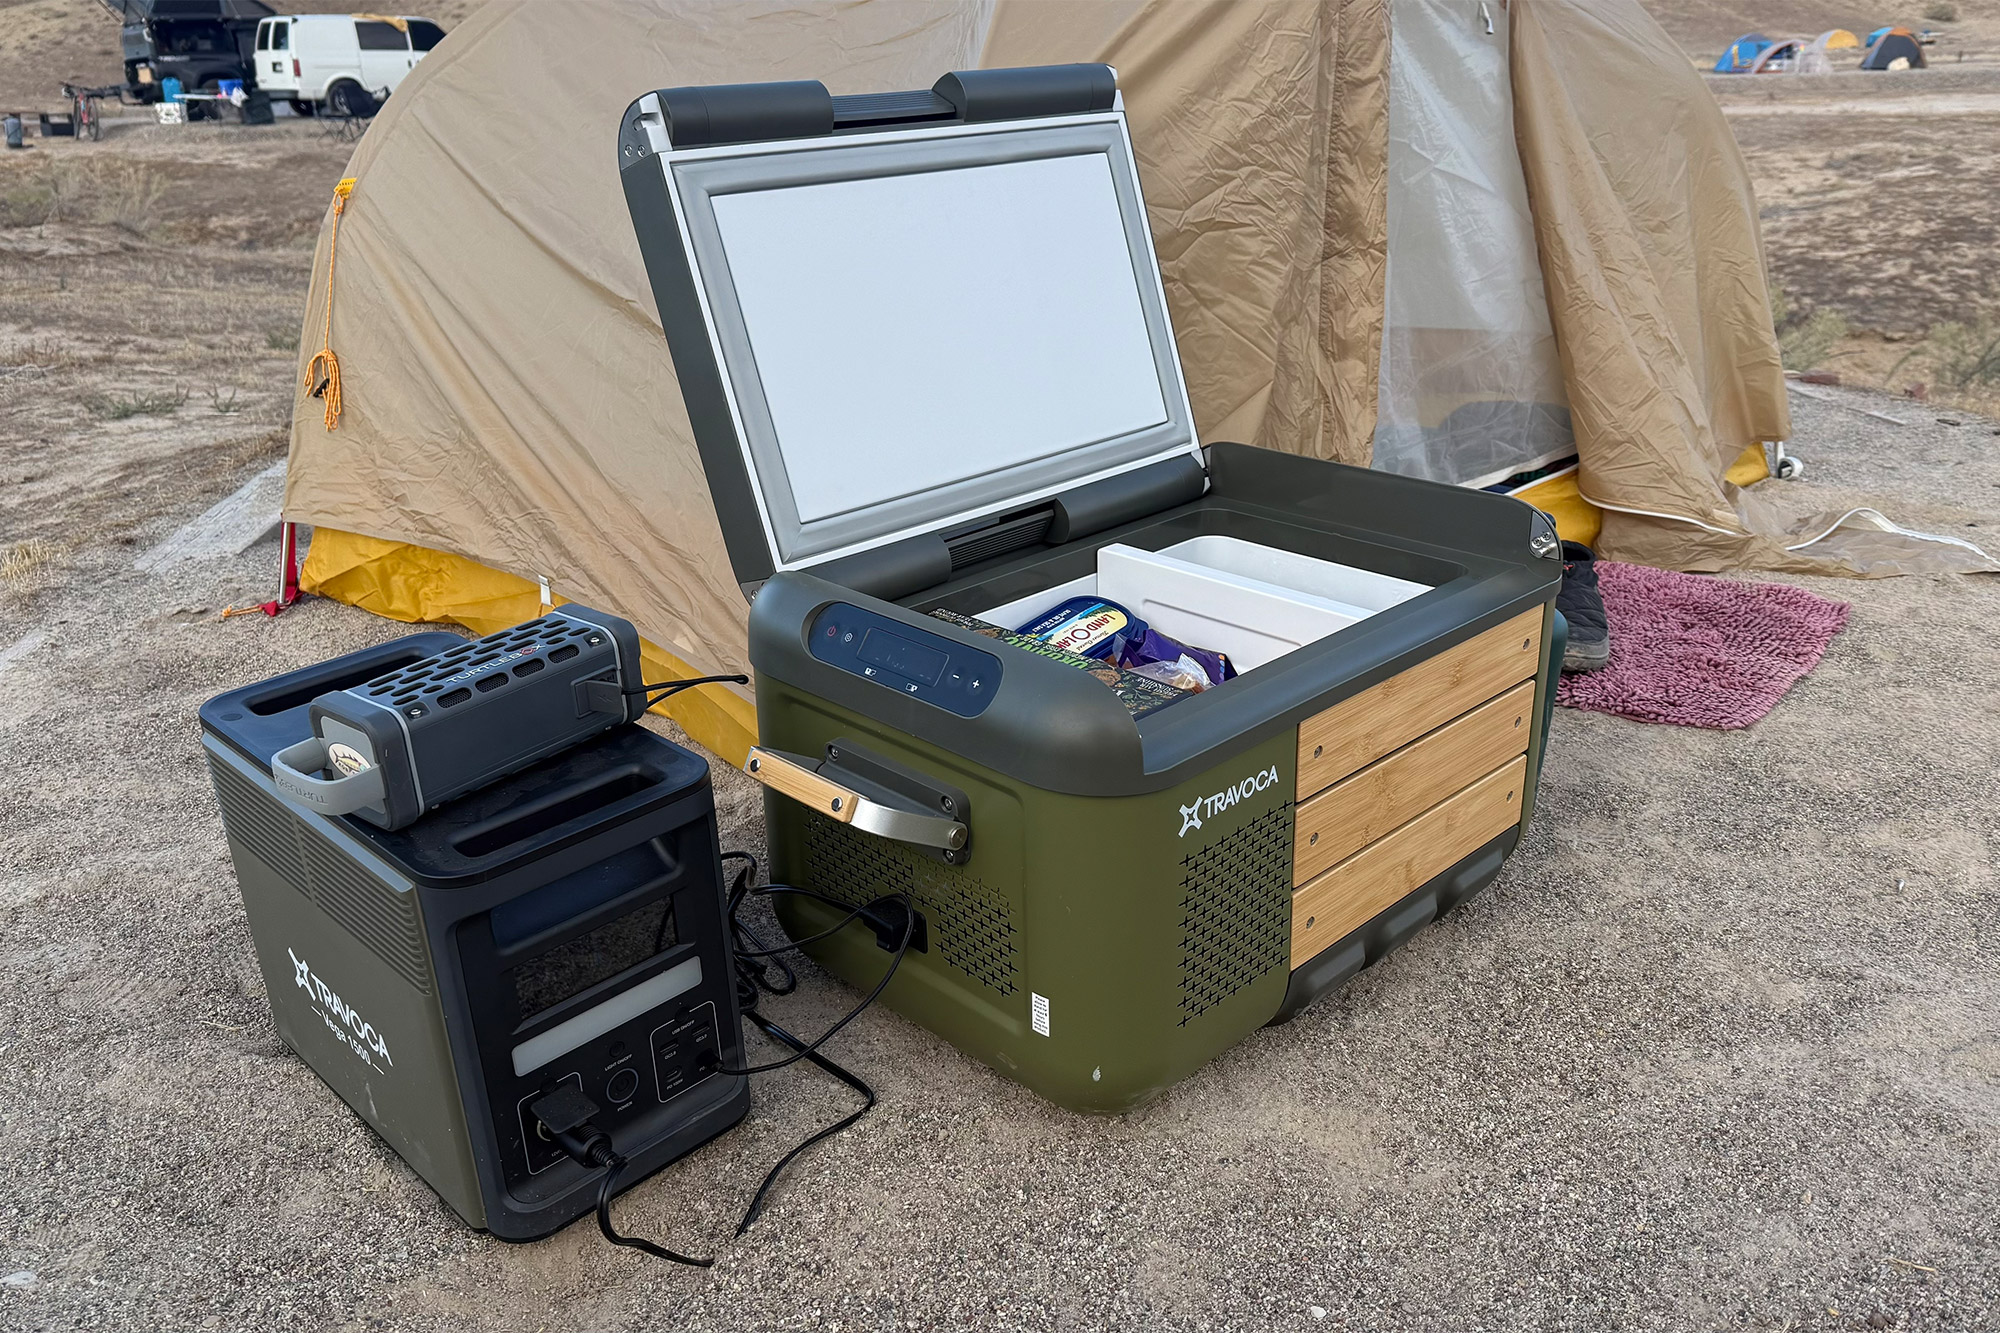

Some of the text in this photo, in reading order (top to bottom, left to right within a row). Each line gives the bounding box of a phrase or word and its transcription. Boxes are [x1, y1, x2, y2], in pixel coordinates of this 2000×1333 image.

[1070, 628, 1091, 640] O
[1086, 614, 1116, 632] LAND
[446, 644, 546, 684] TURTLEBOX
[1204, 765, 1279, 818] TRAVOCA
[310, 972, 394, 1066] TRAVOCA
[348, 1035, 371, 1066] 1500
